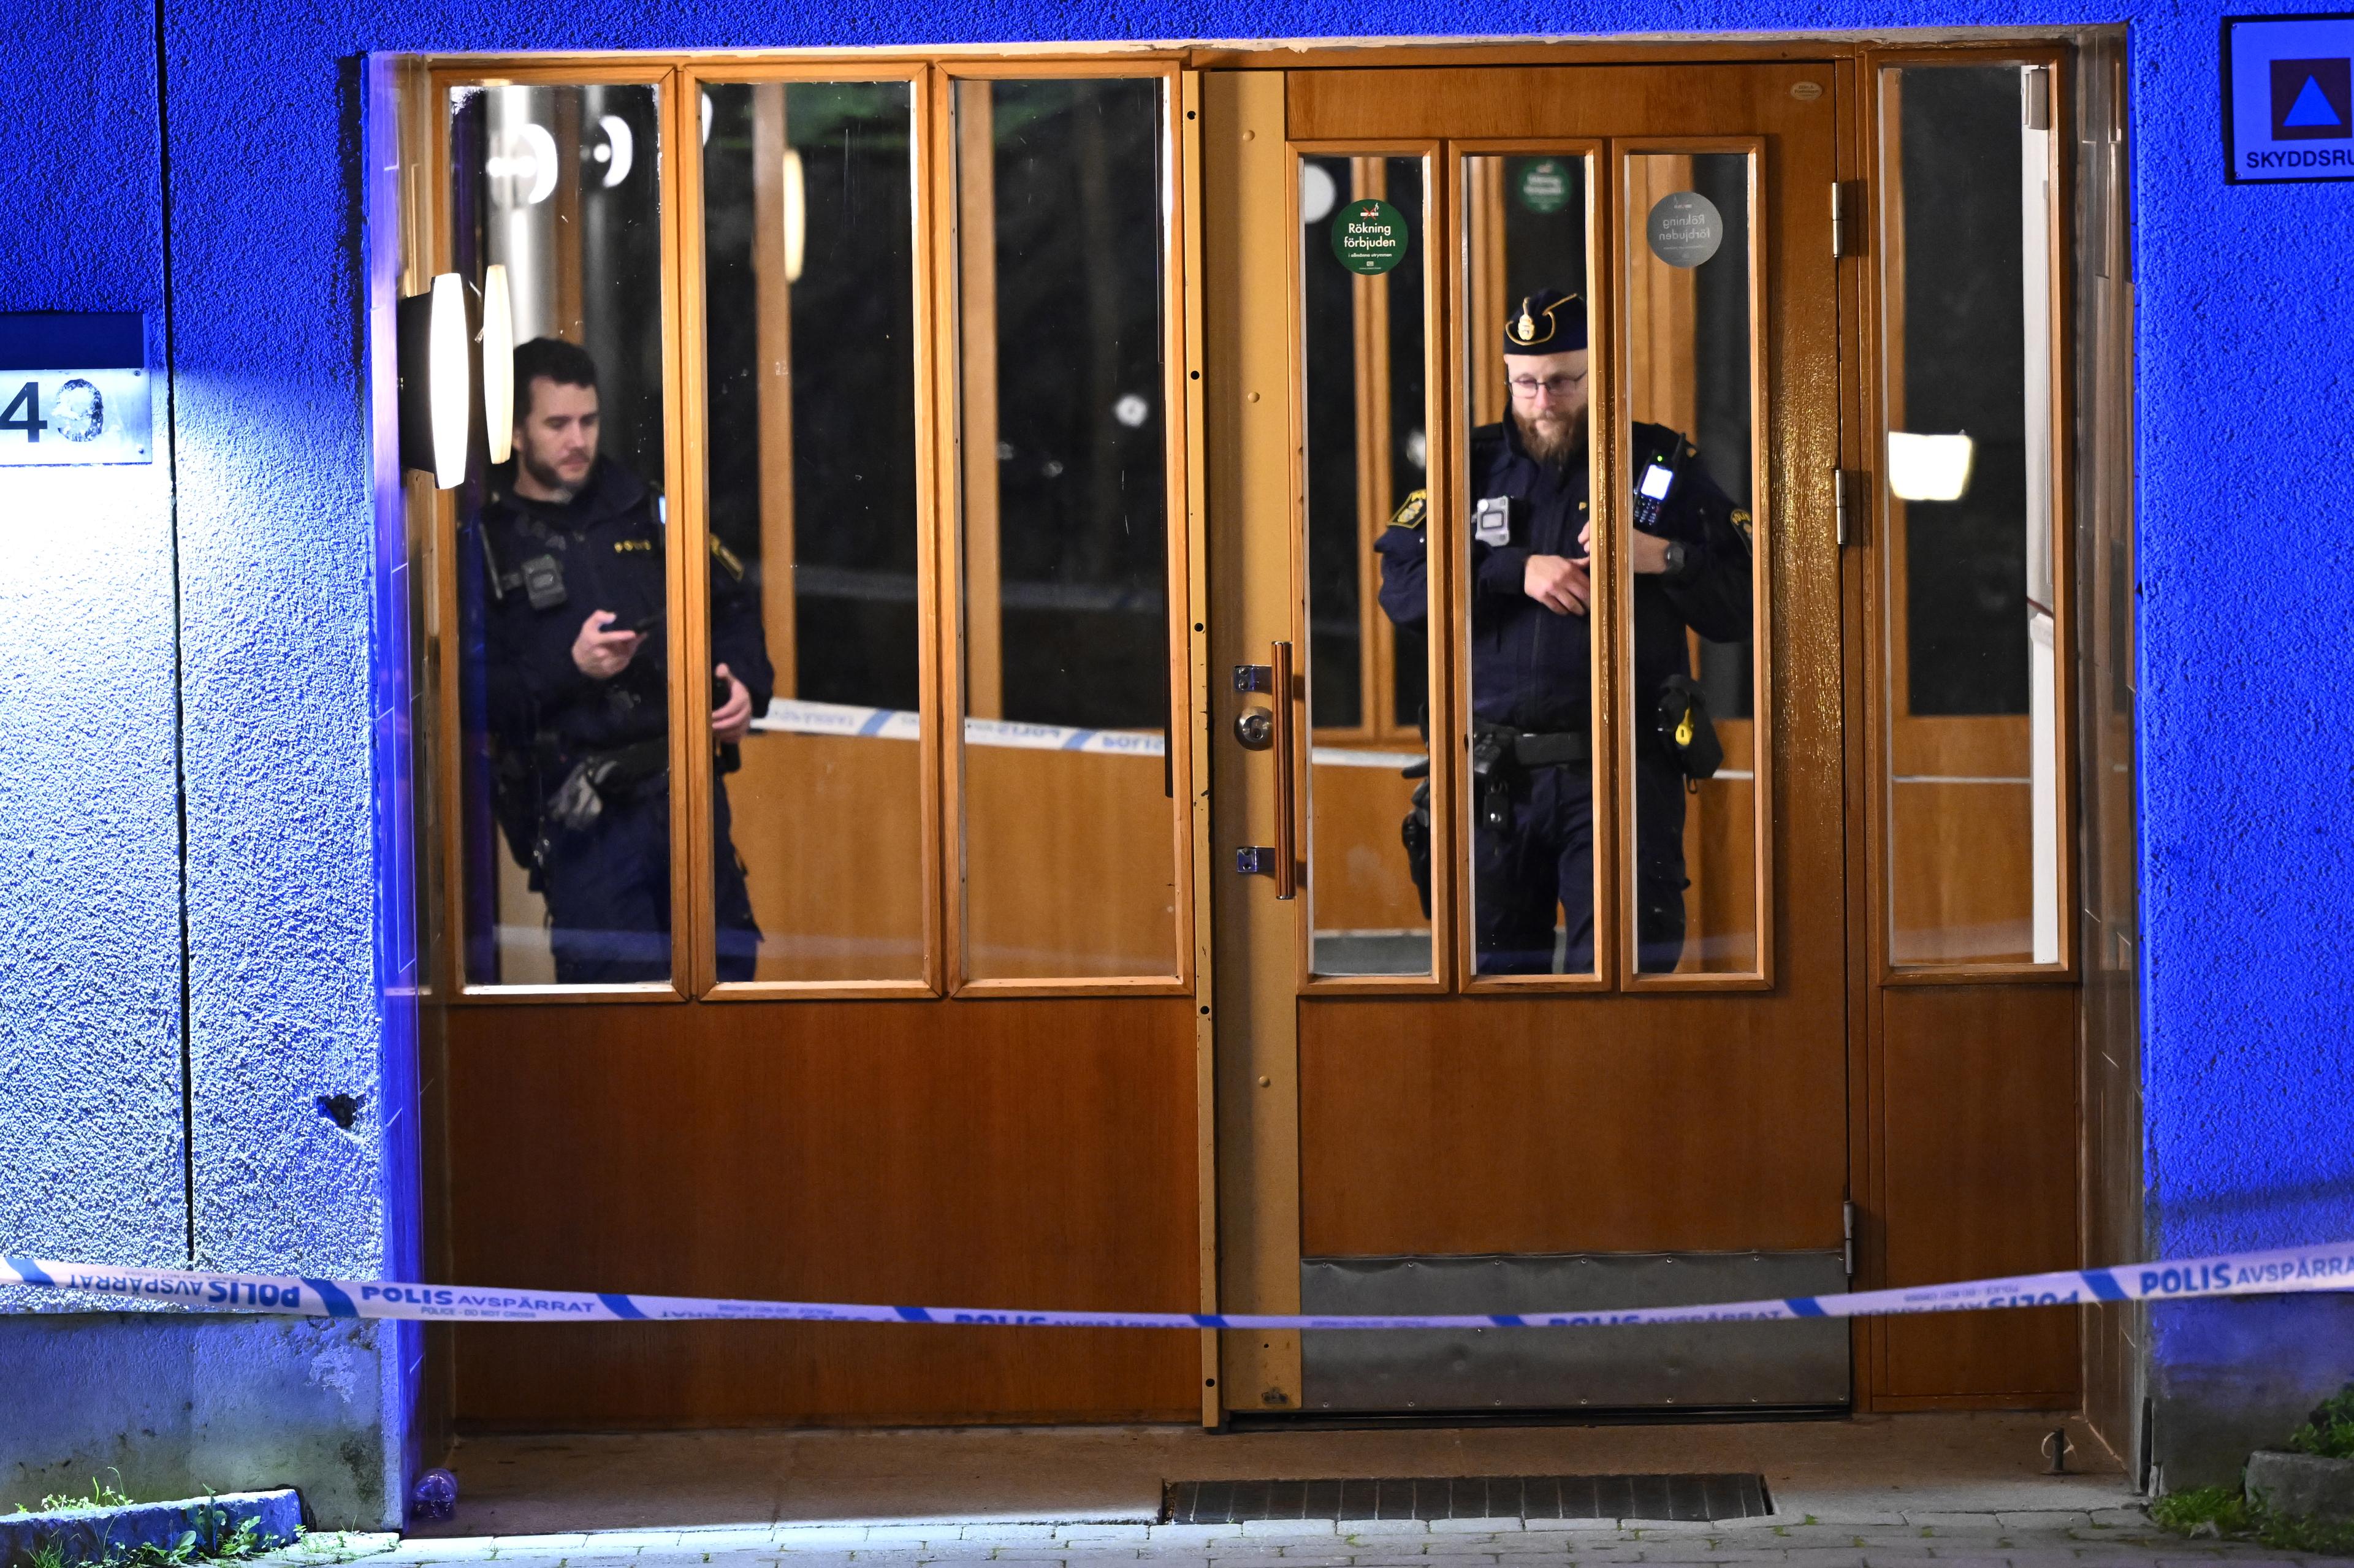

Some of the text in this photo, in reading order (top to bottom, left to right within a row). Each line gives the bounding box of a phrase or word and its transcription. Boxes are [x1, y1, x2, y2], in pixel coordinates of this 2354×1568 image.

[1344, 235, 1395, 250] förbjuden
[1349, 222, 1391, 236] Rökning
[67, 1274, 300, 1308] POLIS AVSPÄRRAT
[2139, 1263, 2231, 1295] POLIS
[360, 1285, 595, 1313] POLIS AVSPÄRRAT
